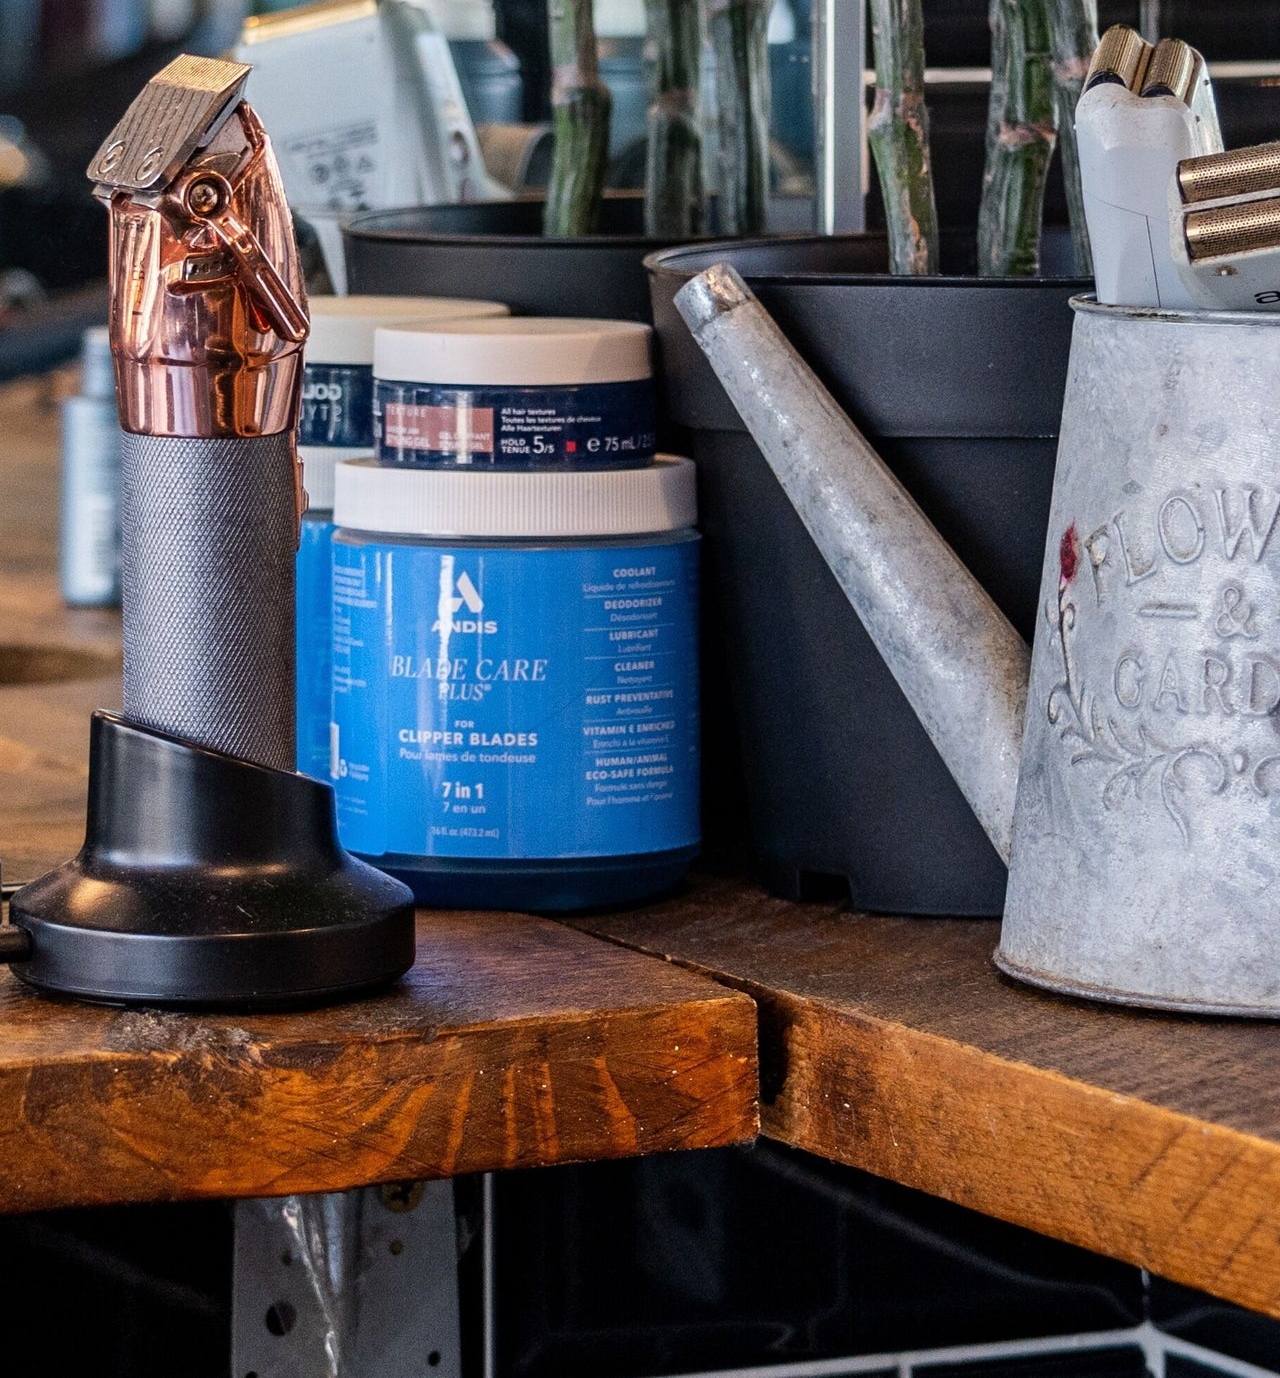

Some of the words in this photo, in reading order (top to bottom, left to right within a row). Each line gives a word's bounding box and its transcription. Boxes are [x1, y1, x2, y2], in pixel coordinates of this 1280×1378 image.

[501, 416, 524, 424] Toutes
[605, 438, 619, 451] 75
[613, 566, 656, 578] COOLANT
[604, 597, 663, 610] DEODORIZER
[1216, 585, 1258, 639] &
[431, 620, 498, 634] ANDIS
[609, 628, 658, 641] LUBRICANT
[392, 655, 467, 681] BLADE
[476, 659, 548, 681] CARE
[614, 661, 655, 672] CLEANER
[586, 695, 612, 705] RUST
[455, 720, 475, 729] FOR
[583, 725, 626, 736] VITAMIN
[399, 729, 464, 746] CLIPPER
[470, 733, 538, 746] BLADES
[399, 748, 421, 760] Pour
[425, 750, 458, 762] lames
[461, 751, 476, 763] de
[479, 753, 536, 764] tondeuse
[585, 769, 634, 780] ECO-SAFE
[442, 782, 452, 799] 7
[455, 782, 471, 799] in
[475, 783, 484, 799] 1
[443, 802, 450, 813] 7
[453, 804, 468, 814] en
[471, 804, 486, 814] un
